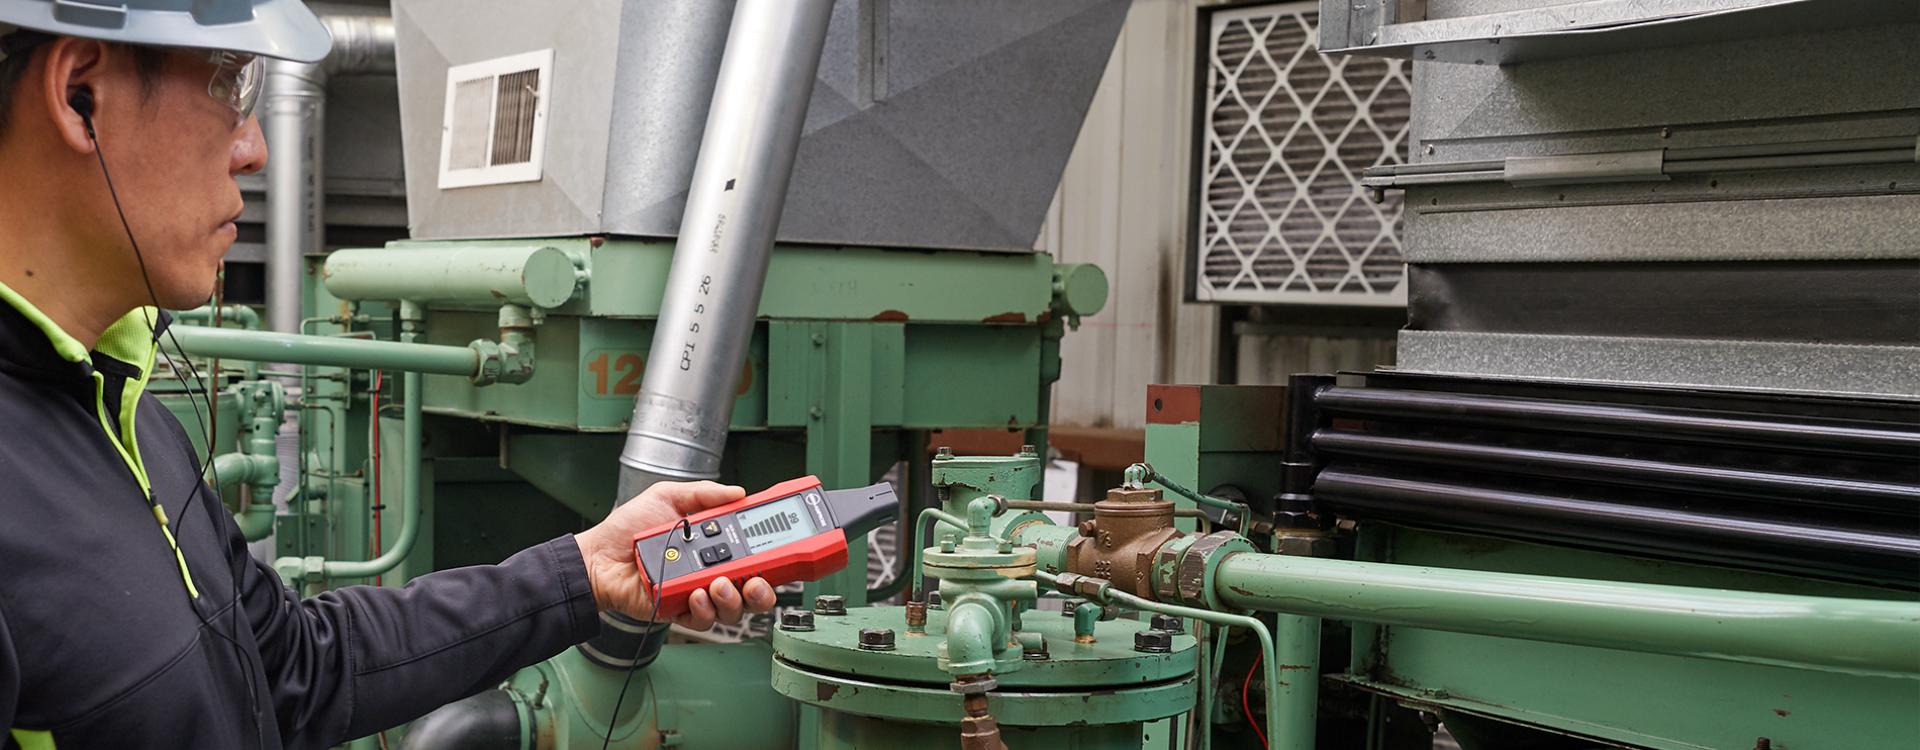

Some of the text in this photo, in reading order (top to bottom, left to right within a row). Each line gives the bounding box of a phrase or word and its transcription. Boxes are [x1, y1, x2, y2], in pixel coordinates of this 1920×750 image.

[680, 275, 711, 371] CPI 5 5 26
